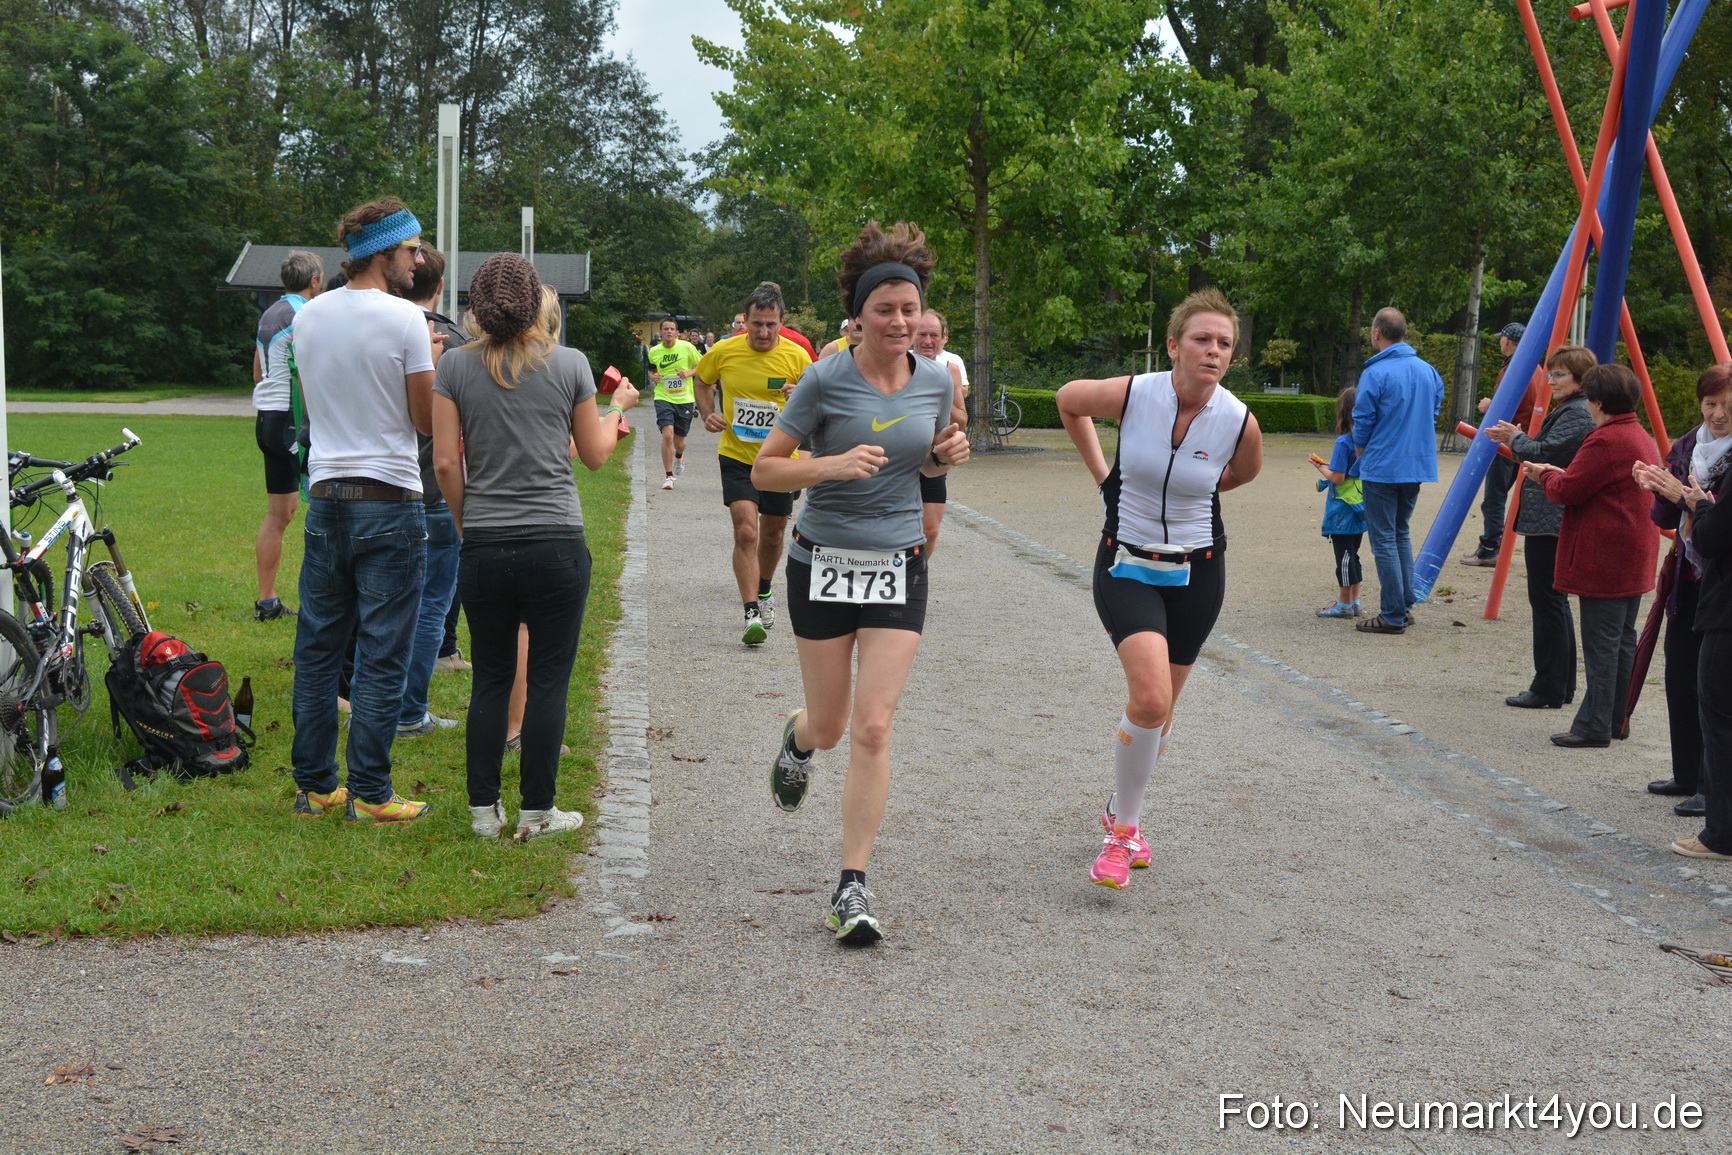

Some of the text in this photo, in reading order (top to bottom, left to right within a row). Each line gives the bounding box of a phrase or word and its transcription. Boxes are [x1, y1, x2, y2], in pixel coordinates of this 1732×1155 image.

[663, 354, 679, 362] RUN
[668, 380, 682, 389] 289
[737, 408, 775, 427] 2282
[744, 429, 763, 438] Albert
[44, 519, 66, 544] STING
[814, 554, 890, 567] PARTL Neumarkt
[820, 567, 897, 600] 2173
